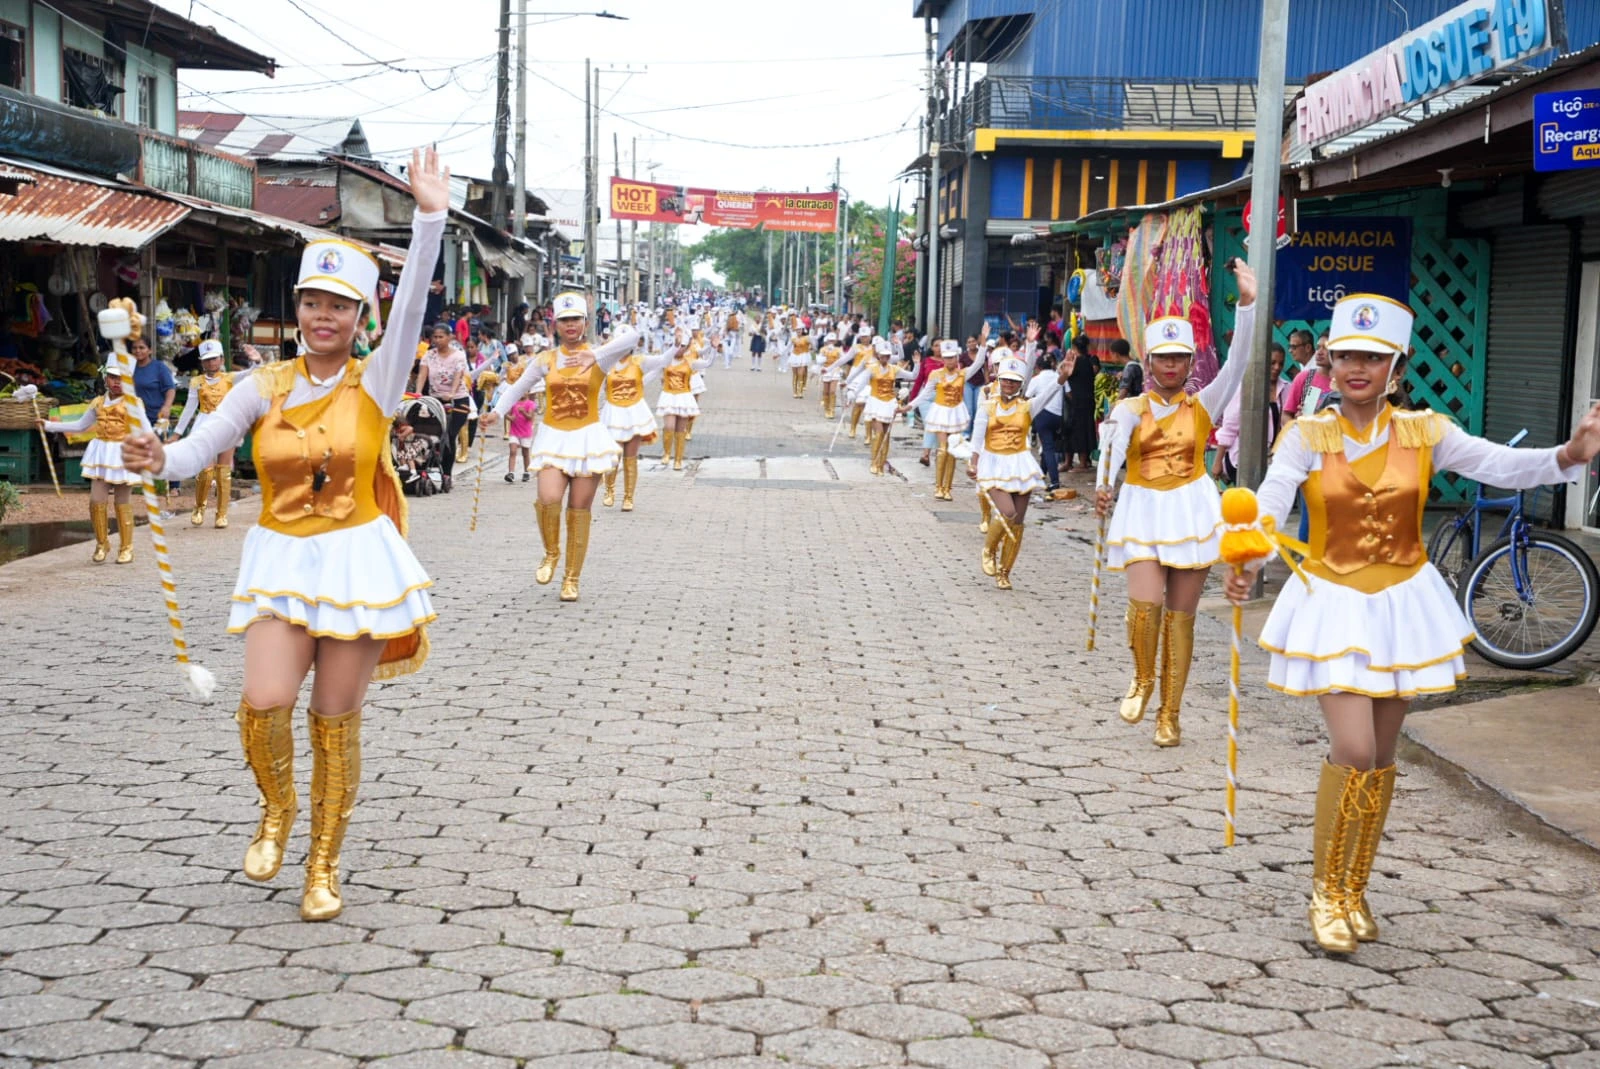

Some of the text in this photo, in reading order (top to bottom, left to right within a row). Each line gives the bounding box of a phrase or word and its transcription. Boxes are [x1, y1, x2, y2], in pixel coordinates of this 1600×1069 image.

[1296, 46, 1404, 145] FARMACIA
[1400, 8, 1493, 103] JOSUE
[1545, 128, 1600, 143] Recarg
[617, 187, 652, 202] HOT
[617, 201, 652, 213] WEEK
[1290, 231, 1395, 248] FARMACIA
[1307, 255, 1374, 272] JOSUE
